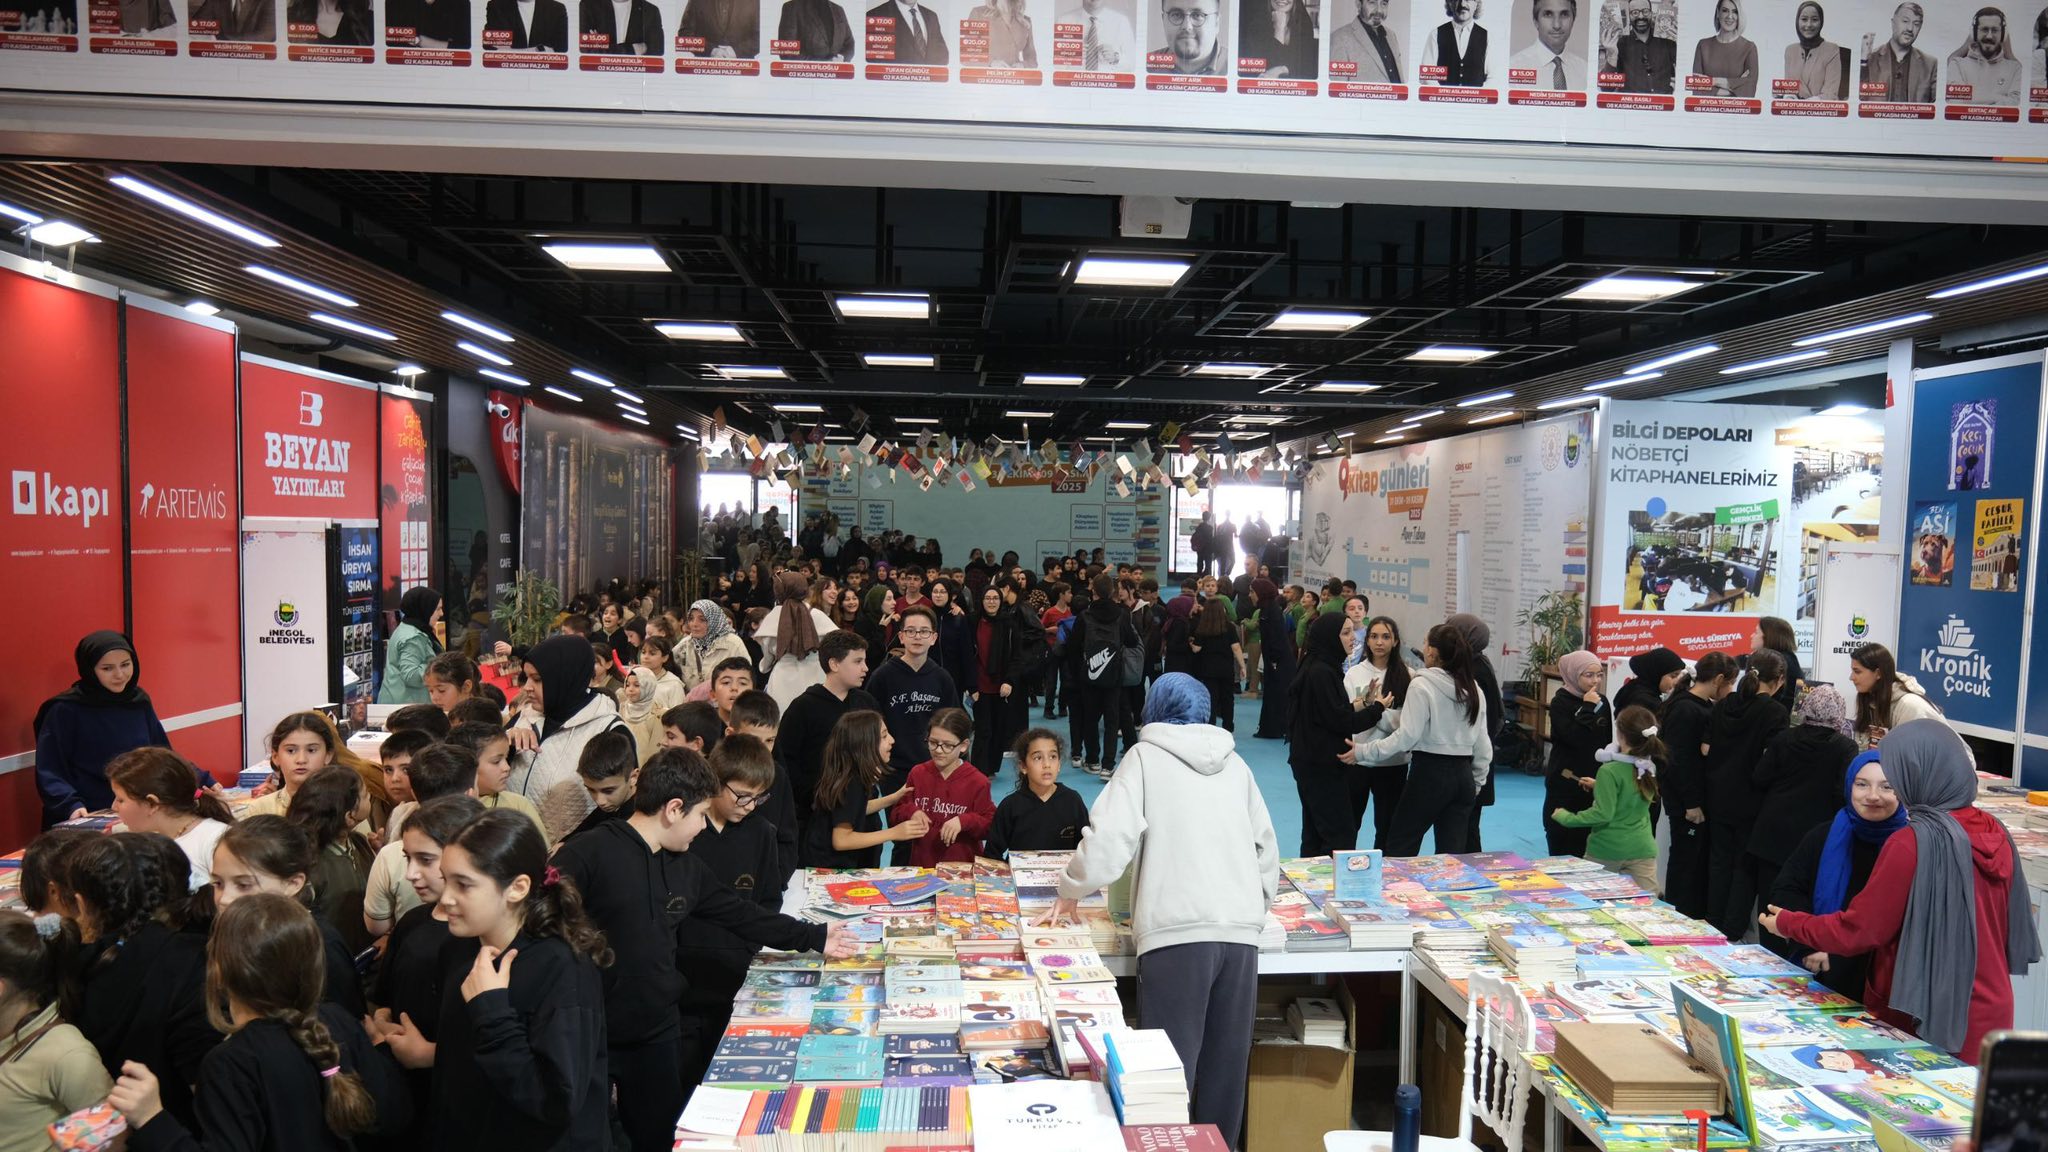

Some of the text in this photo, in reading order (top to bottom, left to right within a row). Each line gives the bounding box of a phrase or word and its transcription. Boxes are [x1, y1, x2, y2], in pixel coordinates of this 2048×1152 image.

[1612, 420, 1753, 443] BİLGİ DEPOLARI
[265, 432, 350, 474] BEYAN
[1612, 444, 1689, 466] NÖBETÇİ
[1348, 470, 1379, 496] kitap
[1380, 456, 1430, 498] günleri
[1610, 465, 1778, 487] KİTAPHANELERİMİZ
[272, 476, 345, 498] YAYINLARI
[44, 472, 108, 528] kapı
[156, 484, 226, 519] ARTEMİS
[1730, 504, 1762, 515] GENÇLİK
[1730, 513, 1764, 524] MERKEZİ
[348, 542, 372, 556] İHSAN
[342, 561, 372, 576] ÜREYYA
[348, 579, 372, 593] SIRMA
[260, 636, 315, 645] BELEDİYESİ
[269, 629, 305, 637] İNEGÖL
[1680, 632, 1742, 646] CEMAL SÜREYYA
[1688, 640, 1733, 652] SEVDA SÖZLERİ
[1842, 640, 1872, 648] İNEGÖ
[1090, 647, 1110, 671] NIKE
[1920, 648, 1992, 681] Kronik
[1944, 676, 1991, 698] Çocuk
[911, 691, 941, 705] Başaran
[1152, 1127, 1174, 1148] GELDİ
